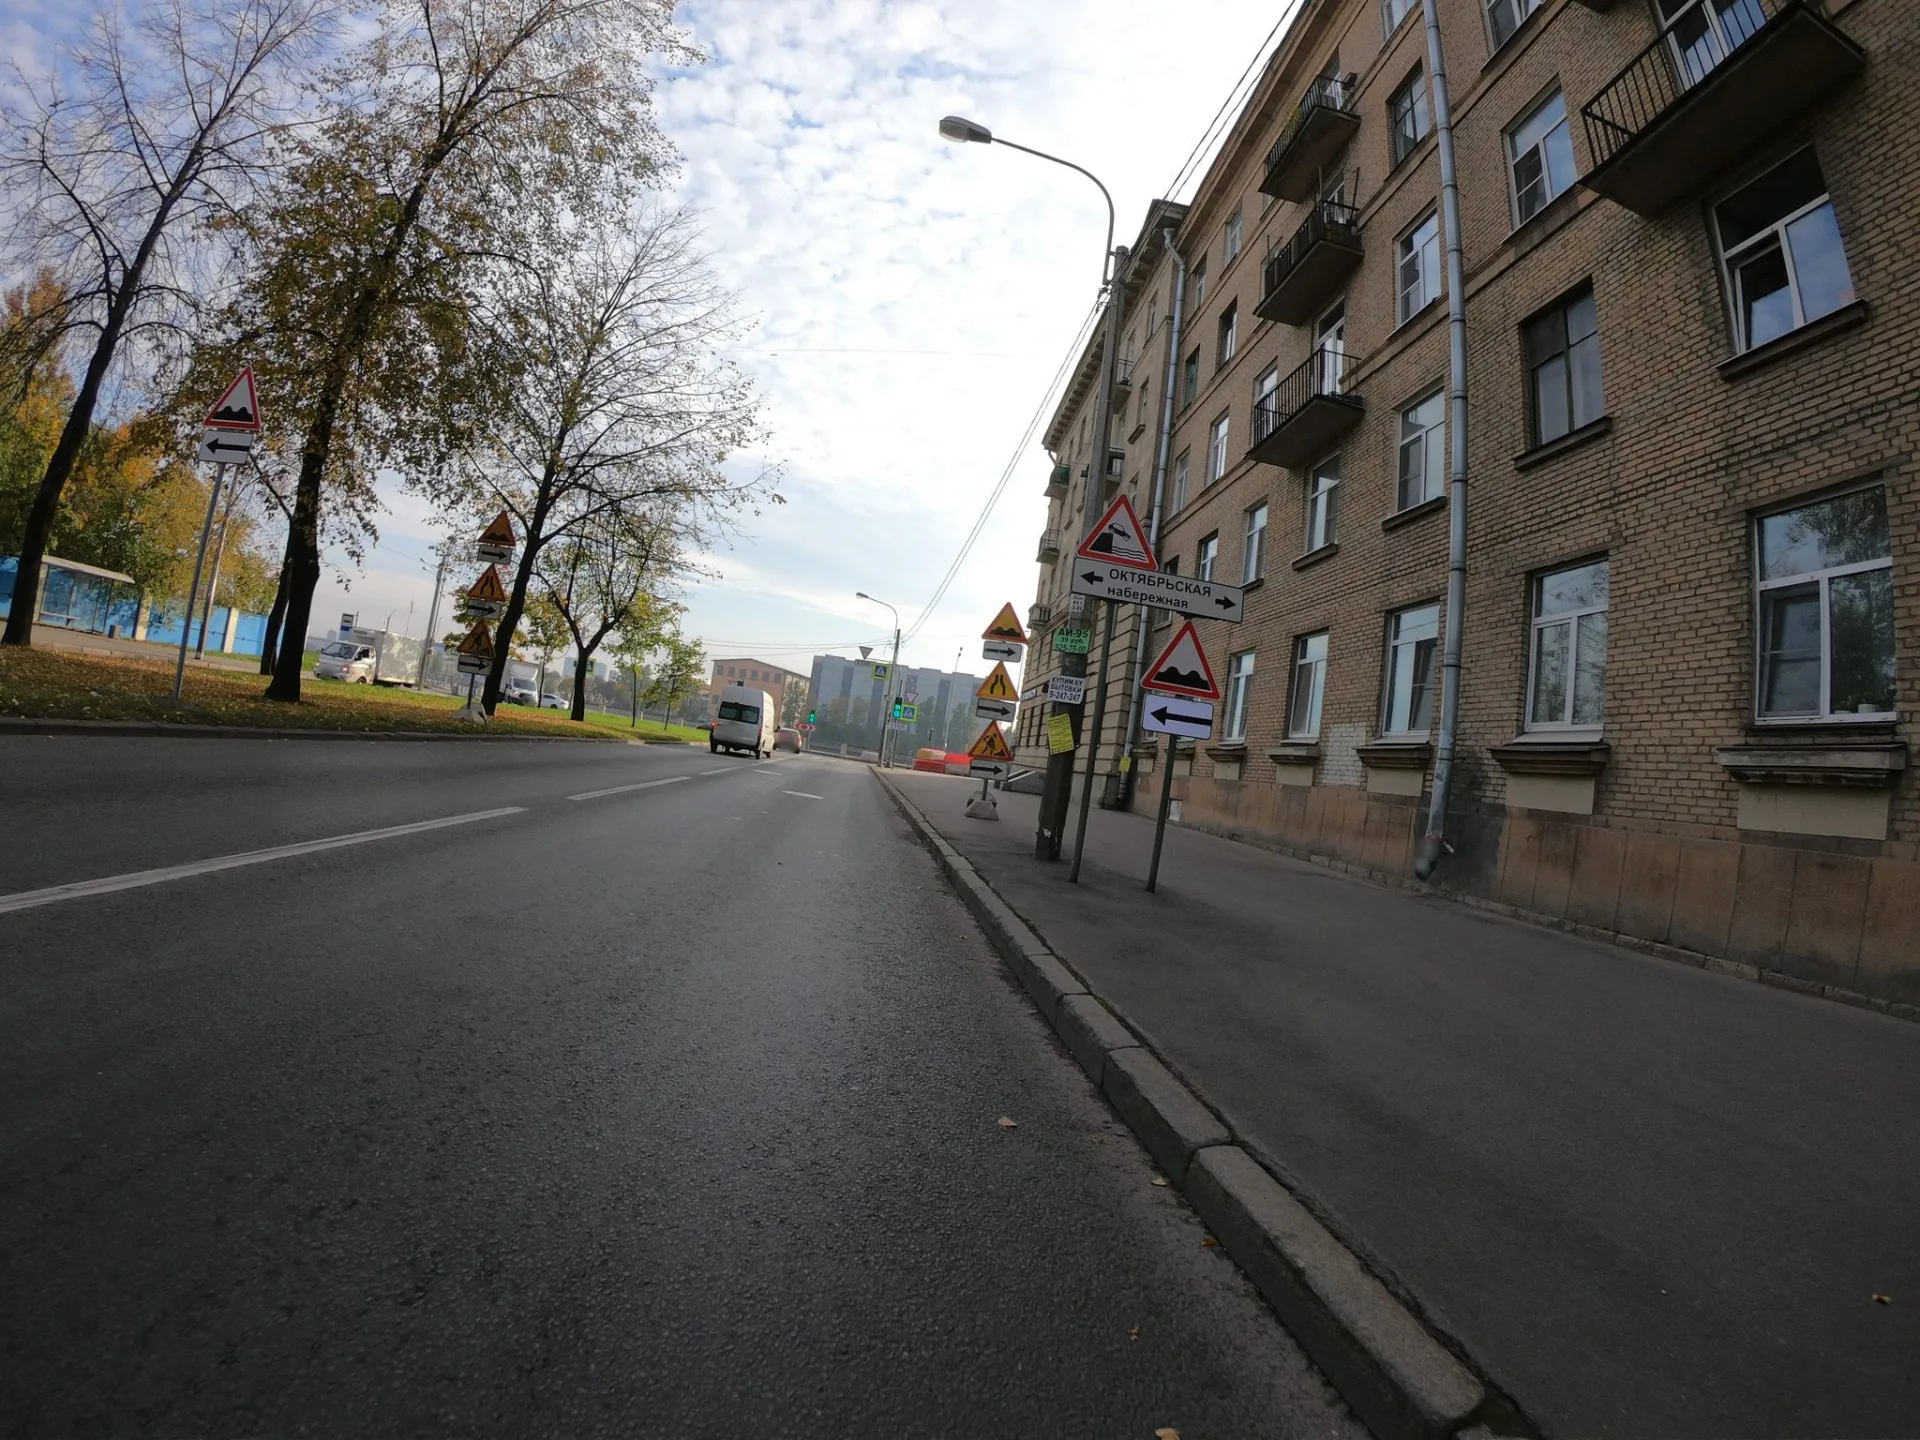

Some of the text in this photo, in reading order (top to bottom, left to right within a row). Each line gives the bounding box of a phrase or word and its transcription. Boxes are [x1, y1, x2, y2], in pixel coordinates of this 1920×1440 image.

[1109, 568, 1211, 597] ОКТЯБРЬСКАЯ
[1107, 586, 1189, 609] набережная
[1058, 628, 1088, 638] АИ-95
[1051, 676, 1074, 685] КУПИМ
[1050, 683, 1082, 693] БЫТОВКИ
